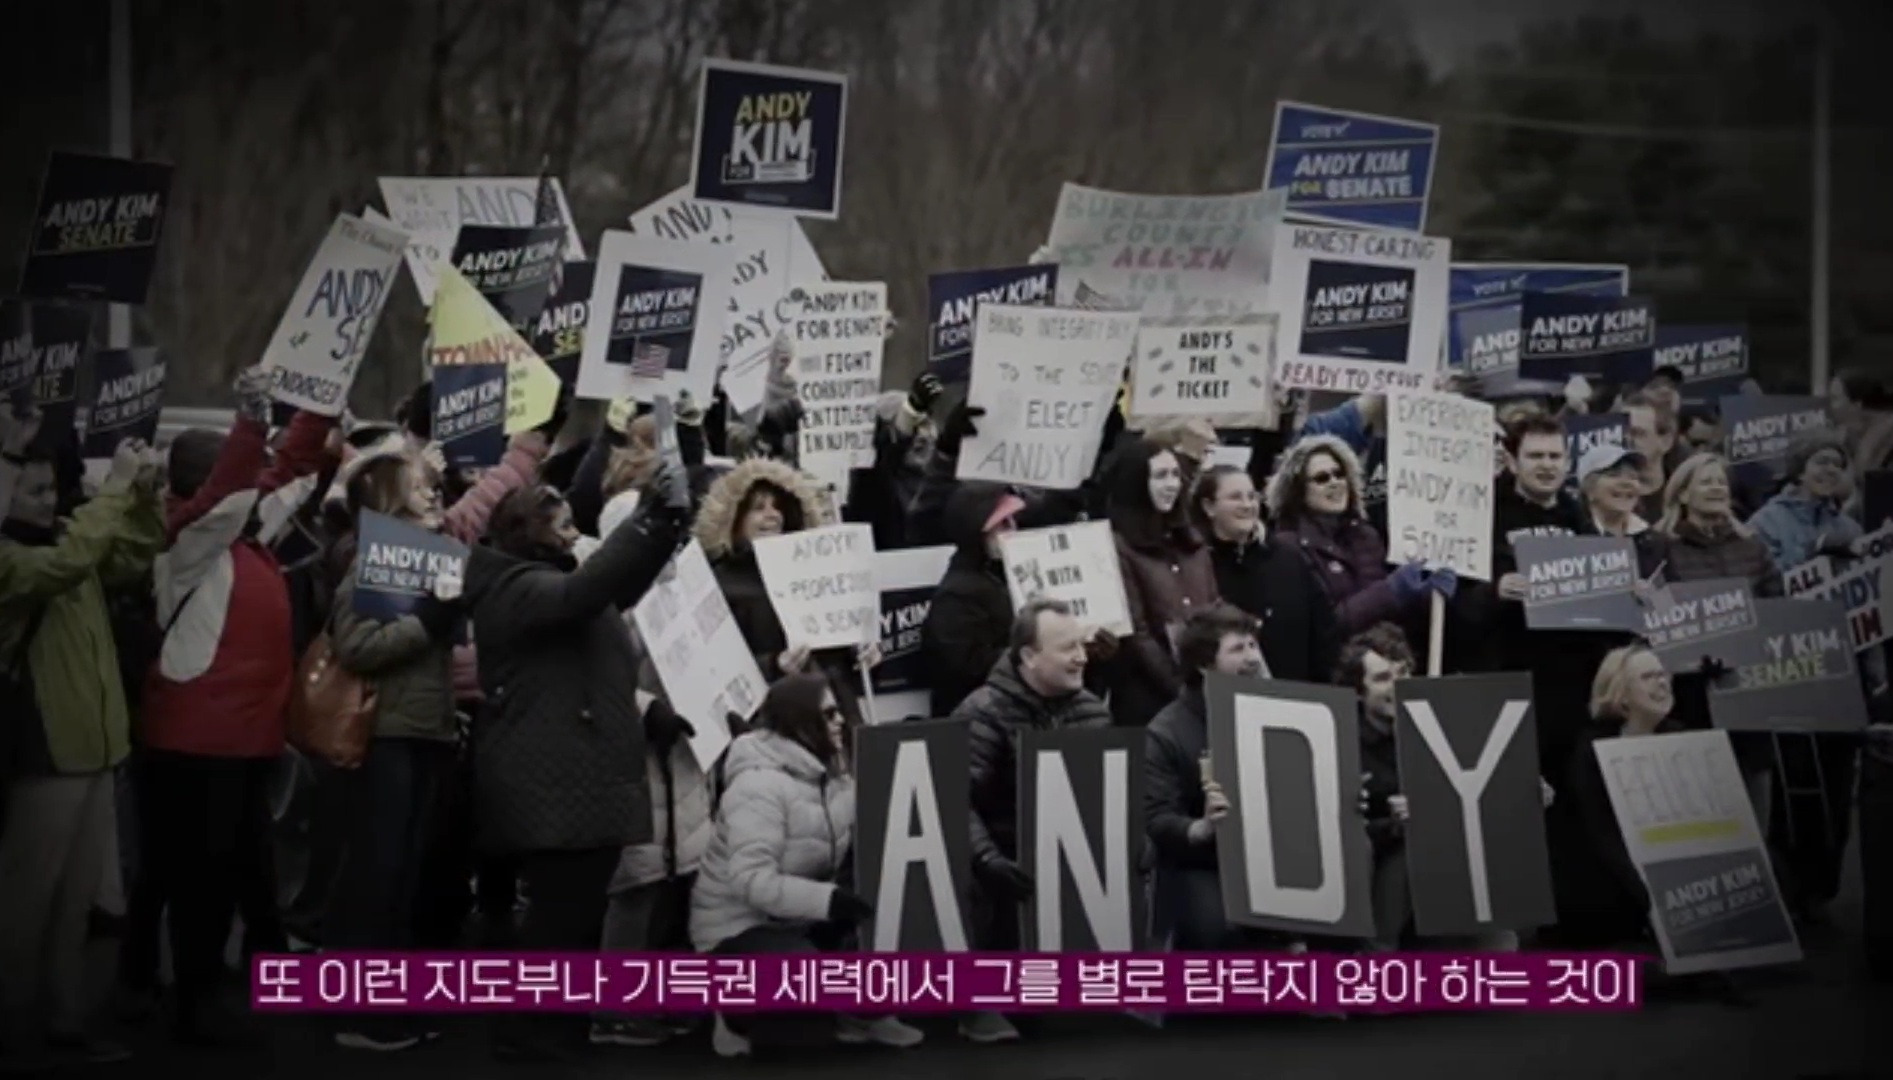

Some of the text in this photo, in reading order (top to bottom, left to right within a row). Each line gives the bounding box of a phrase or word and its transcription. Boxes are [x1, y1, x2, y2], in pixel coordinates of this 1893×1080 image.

[738, 90, 813, 123] ANDY
[730, 118, 813, 166] KIM
[1293, 147, 1412, 178] ANDY KIM
[1325, 174, 1414, 199] SENATE
[43, 192, 160, 229] ANDY KIM
[58, 219, 139, 252] SENATE
[1102, 222, 1246, 248] COUNTY
[1293, 228, 1438, 260] HONEST CARING
[459, 247, 522, 272] ANDY
[1111, 245, 1236, 272] ALL-IN
[619, 289, 665, 315] ANDY
[664, 286, 697, 308] KIM
[802, 290, 848, 313] ANDY
[1006, 272, 1049, 303] KIM
[1313, 278, 1409, 307] ANDY KIM
[796, 319, 830, 341] FOR
[1336, 306, 1365, 323] NEW
[1530, 305, 1650, 338] ANDY KIM
[1528, 327, 1648, 353] FOR NEW JERSEY
[1702, 334, 1743, 359] KIM
[44, 341, 79, 373] KIM
[825, 351, 873, 375] FIGHT
[1188, 355, 1217, 375] THE
[97, 367, 144, 407] ANDY
[998, 360, 1022, 384] TO
[1034, 363, 1066, 386] THE
[1280, 360, 1343, 389] READY
[1344, 366, 1371, 391] TO
[437, 386, 476, 418] ANDY
[1177, 379, 1231, 400] TICKET
[1025, 398, 1095, 430] ELECT
[1731, 408, 1827, 443] ANDY KIM
[975, 437, 1073, 480] ANDY
[1393, 467, 1453, 504] ANDY
[366, 542, 463, 575] ANDY KIM
[1401, 522, 1480, 571] SENATE
[1045, 564, 1084, 587] WITH
[1529, 548, 1631, 584] ANDY KIM
[1790, 565, 1823, 597] ALL
[1529, 571, 1633, 601] FOR NEW JERSEY
[896, 599, 933, 630] KIM
[1702, 588, 1746, 617] KIM
[1791, 626, 1840, 652] KIM
[1737, 653, 1827, 689] SENATE
[1233, 692, 1346, 924] D
[1402, 698, 1532, 922] Y
[1665, 861, 1761, 911] ANDY KIM
